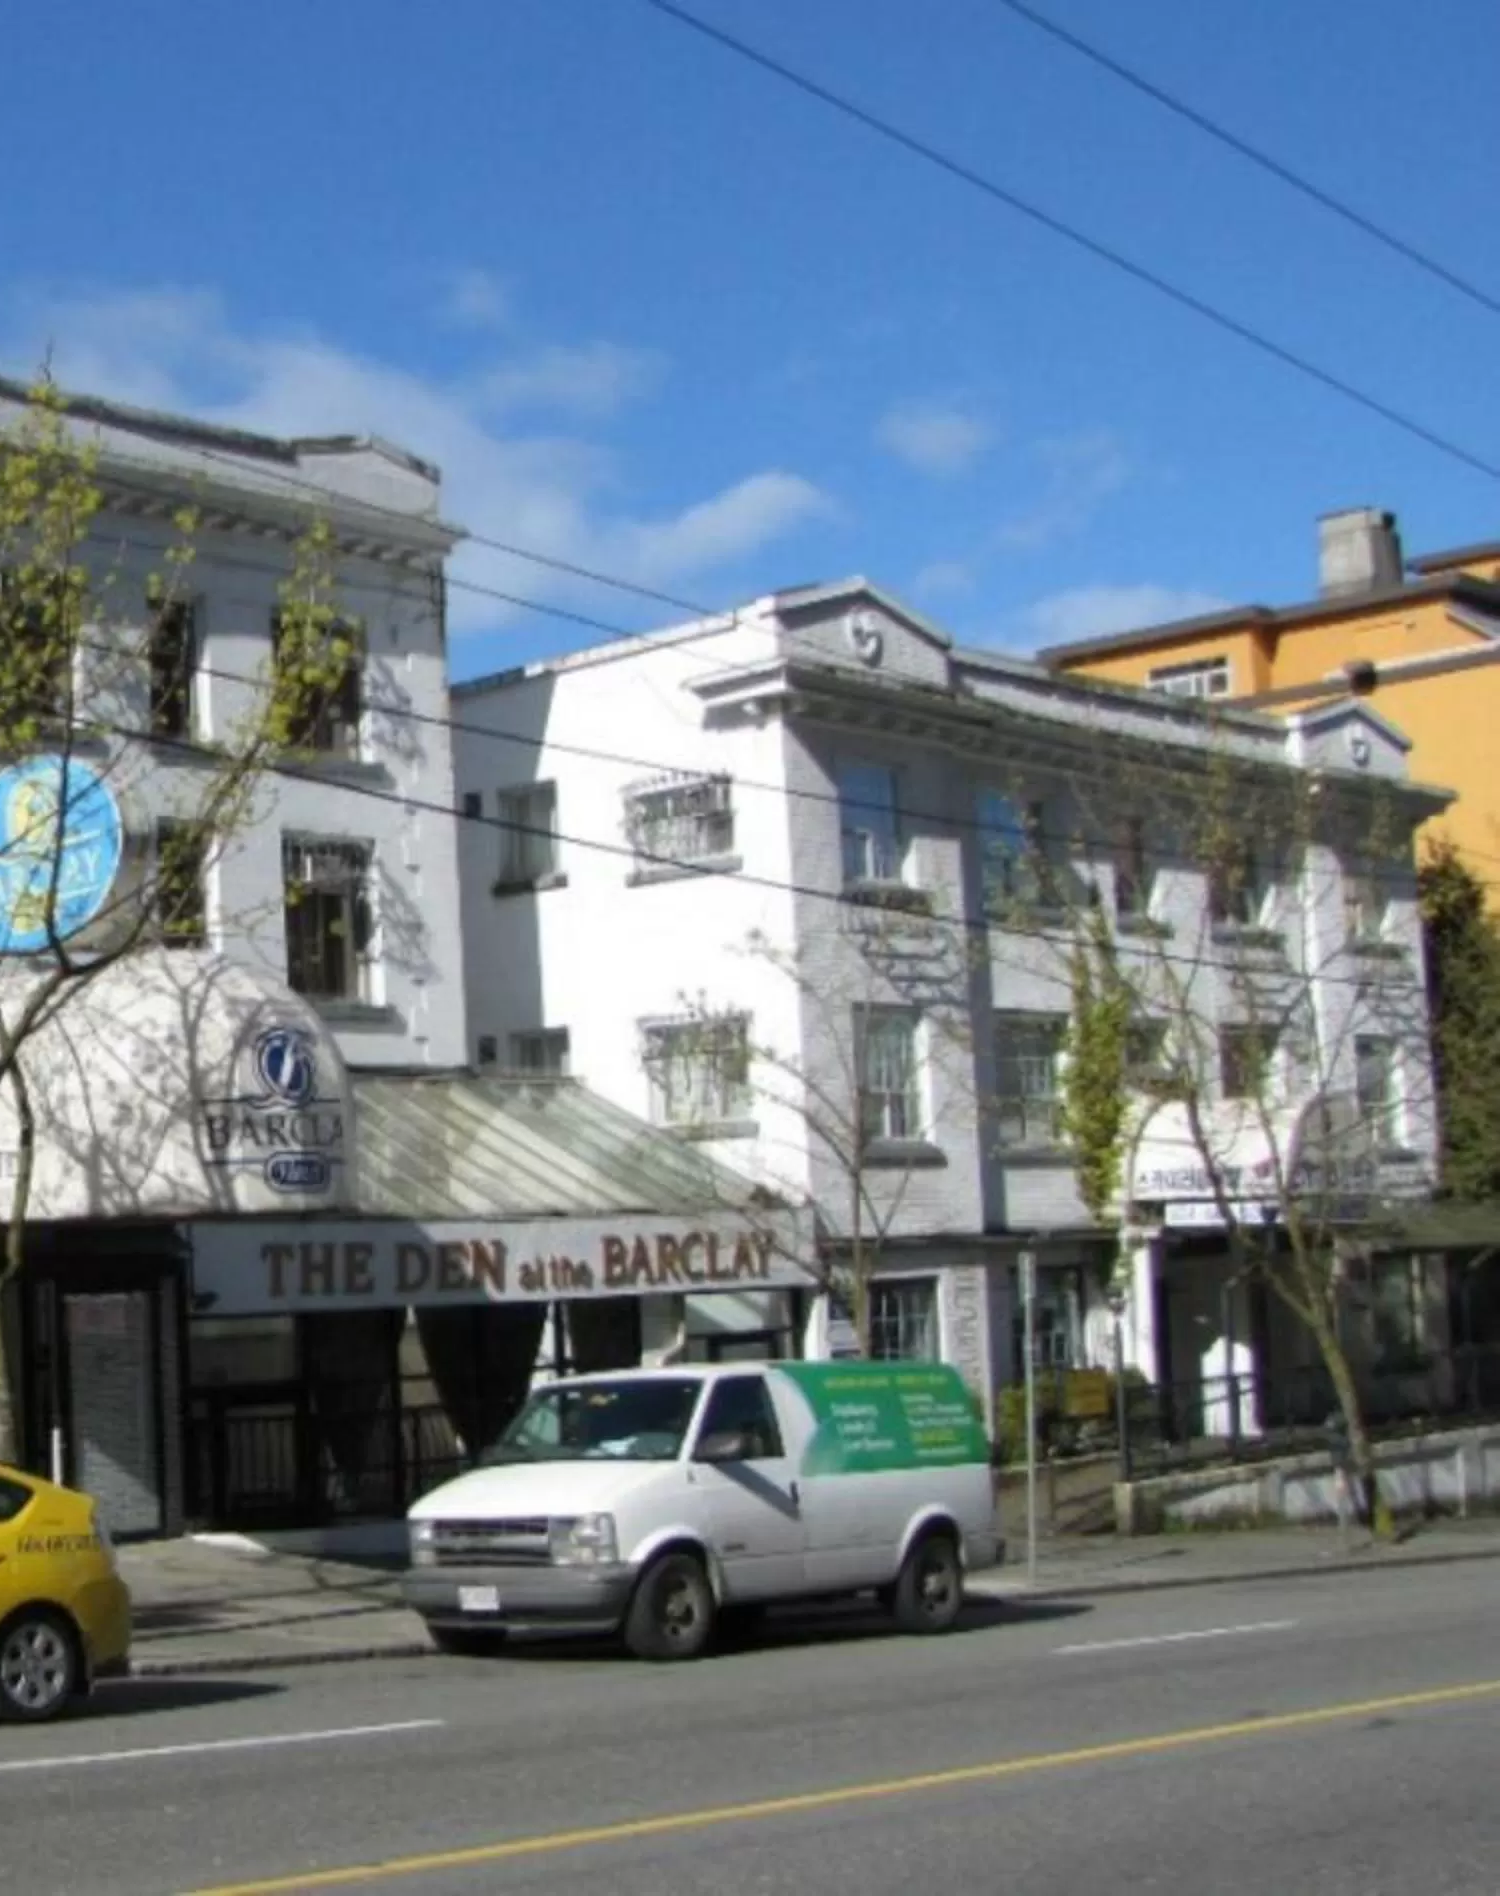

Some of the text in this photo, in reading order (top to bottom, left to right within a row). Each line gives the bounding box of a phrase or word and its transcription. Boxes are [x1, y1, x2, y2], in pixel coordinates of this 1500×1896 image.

[259, 1240, 376, 1297] THE
[393, 1237, 508, 1295] DEN
[548, 1254, 595, 1292] the
[603, 1230, 776, 1288] BARCLAY
